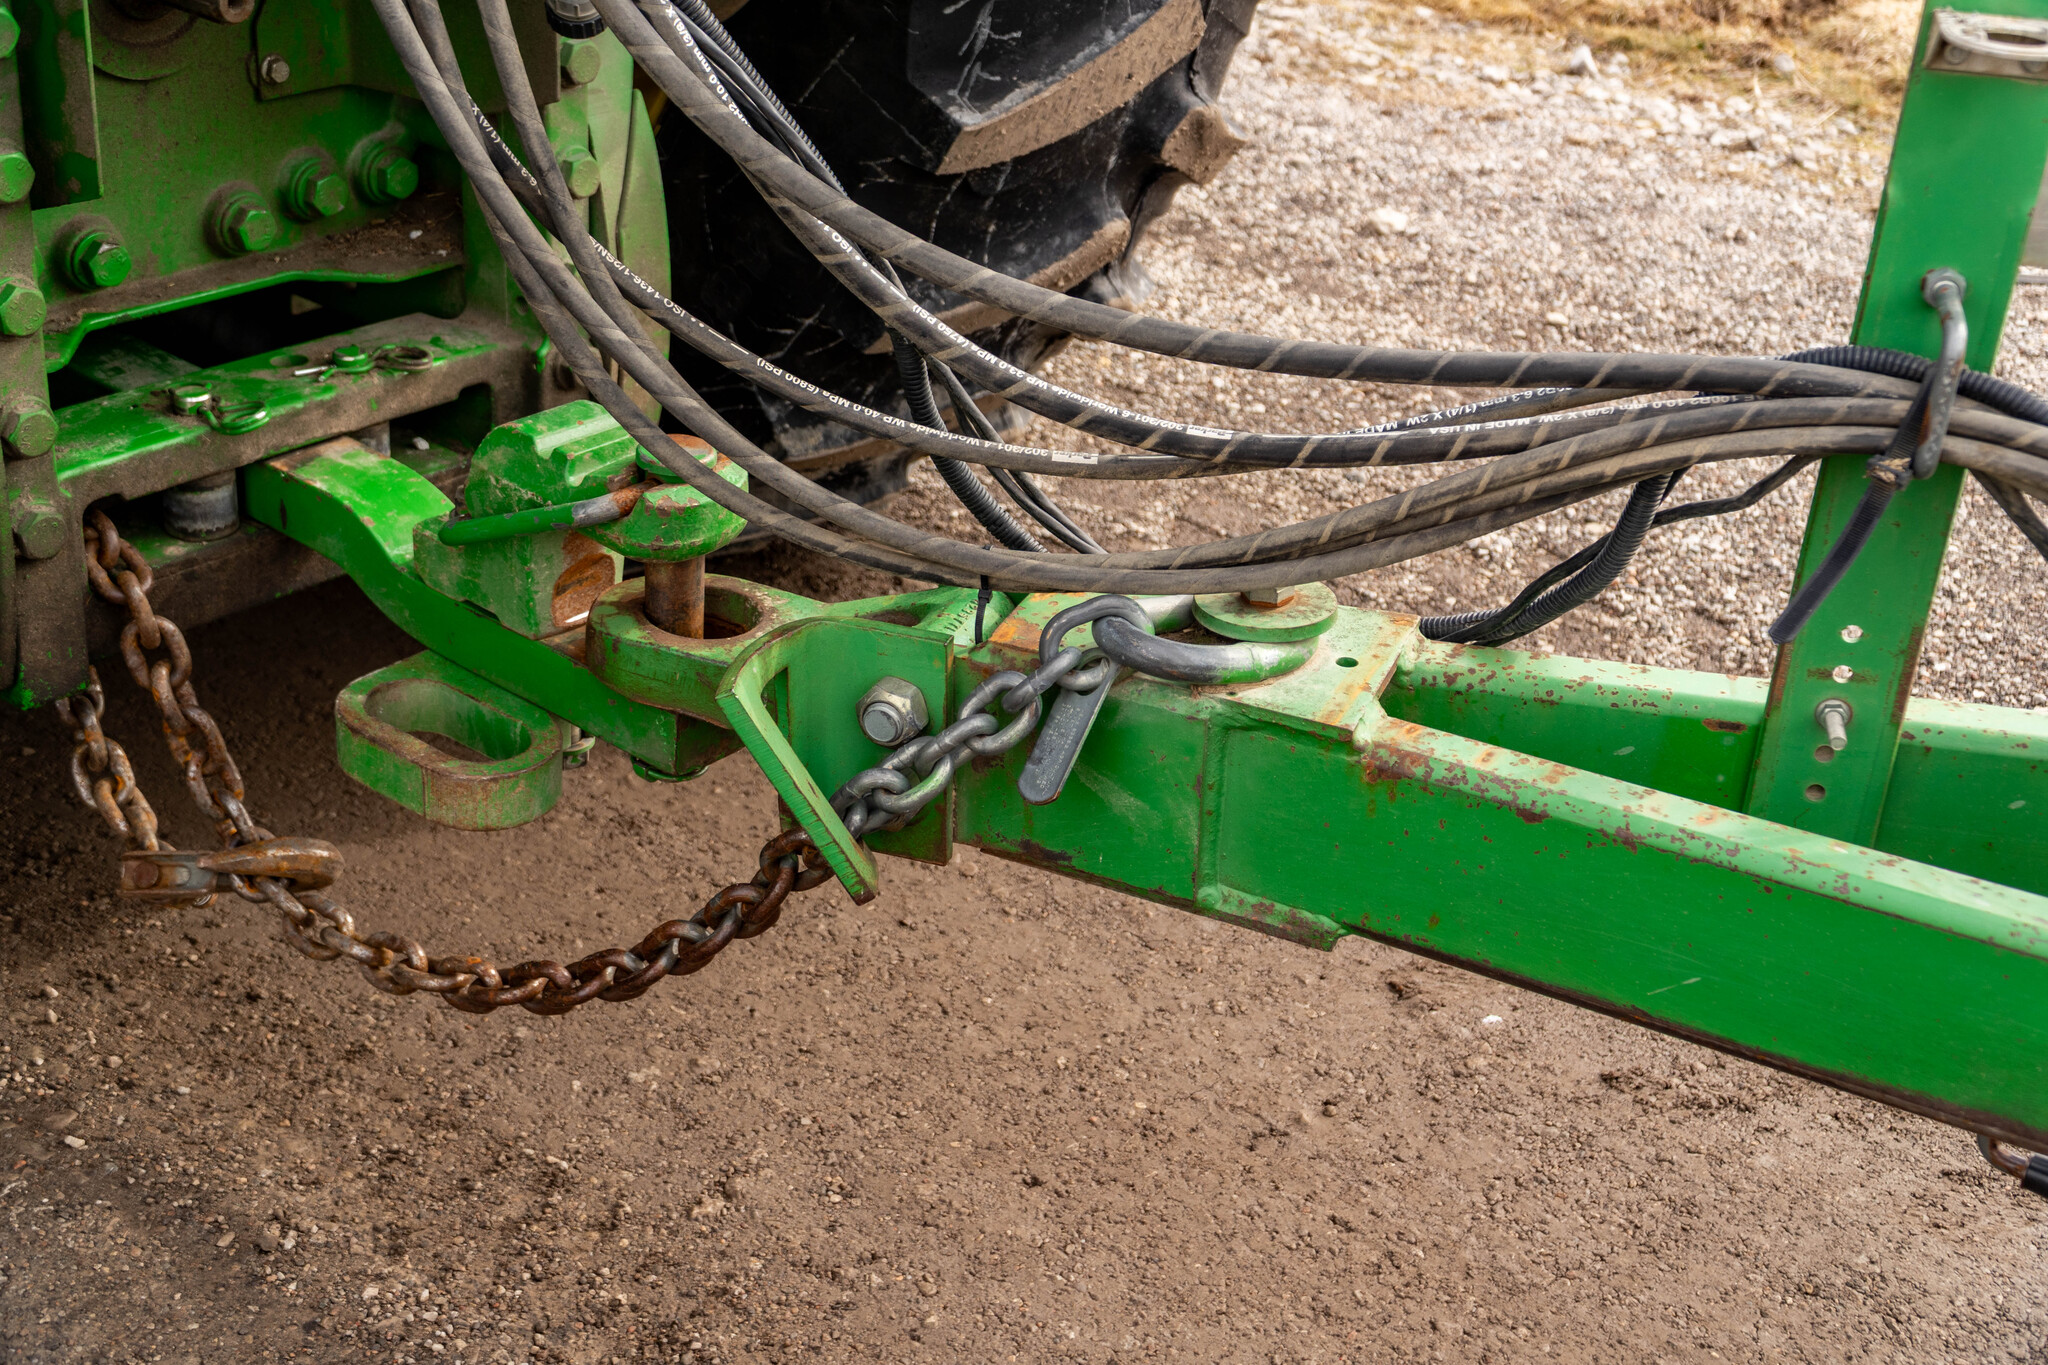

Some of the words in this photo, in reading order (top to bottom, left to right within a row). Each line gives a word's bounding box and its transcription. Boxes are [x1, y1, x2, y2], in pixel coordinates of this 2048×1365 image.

[665, 5, 676, 18] X
[673, 17, 694, 46] (3/8)
[693, 47, 711, 72] mm
[709, 74, 728, 101] 10.0
[479, 115, 501, 143] (1/4)
[832, 232, 853, 253] ISO
[664, 298, 686, 317] ISO
[912, 304, 937, 324] PSI)
[937, 322, 969, 347] (4750
[971, 344, 998, 364] MPa
[757, 358, 783, 376] PSI)
[999, 361, 1026, 378] 33.0
[785, 373, 819, 394] (5800
[822, 390, 850, 408] MPa
[1051, 385, 1118, 415] Worldwide
[853, 404, 881, 418] 40.0
[1122, 410, 1185, 430] 302/301-6
[1407, 414, 1428, 426] 2W
[1432, 411, 1442, 420] X
[1446, 403, 1476, 418] (1/4)
[1485, 417, 1530, 429] MADE
[984, 441, 1049, 456] 302/301-4
